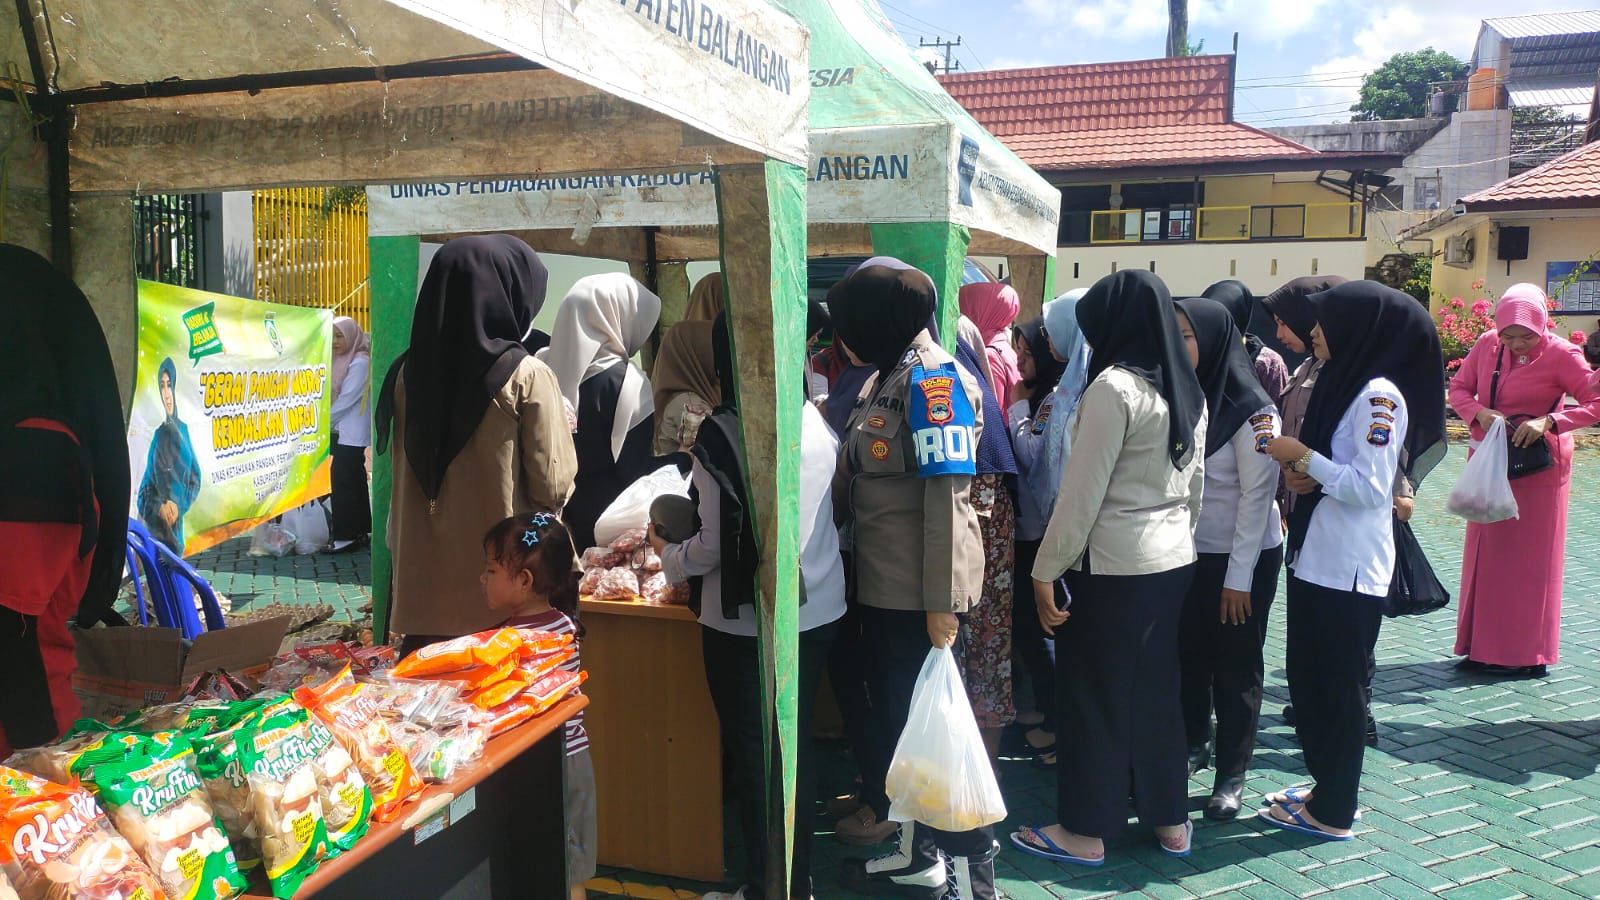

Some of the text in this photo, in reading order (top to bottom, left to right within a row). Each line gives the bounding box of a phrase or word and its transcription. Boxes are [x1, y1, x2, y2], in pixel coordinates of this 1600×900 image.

[620, 0, 791, 96] ATEN BALANGAN
[391, 183, 450, 198] DINAS
[807, 154, 908, 182] ANGAN
[248, 370, 290, 404] PANGAN
[212, 408, 286, 451] KENDALIKAN
